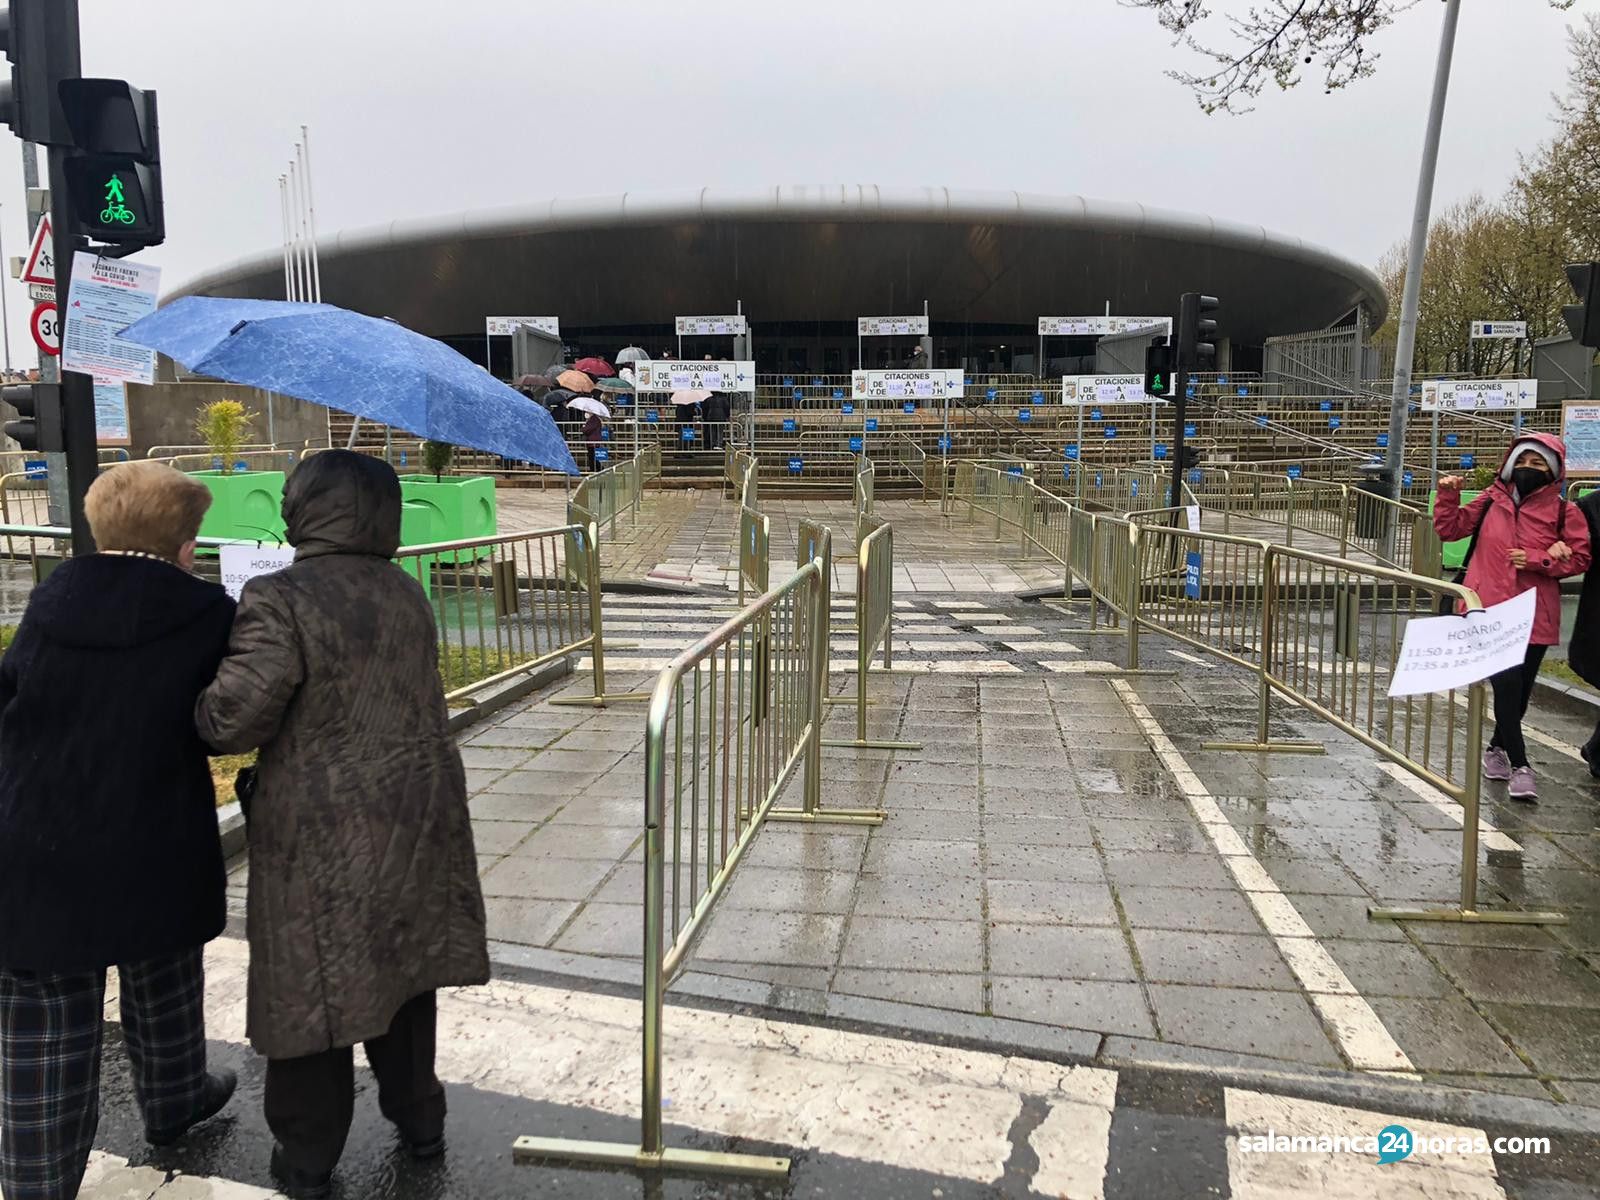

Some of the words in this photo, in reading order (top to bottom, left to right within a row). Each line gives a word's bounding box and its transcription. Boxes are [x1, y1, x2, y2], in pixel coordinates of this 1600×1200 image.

[670, 364, 720, 372] CITACIONES
[884, 373, 931, 381] CITACIONES
[1095, 378, 1141, 386] CITACIONES
[1083, 386, 1095, 394] DE
